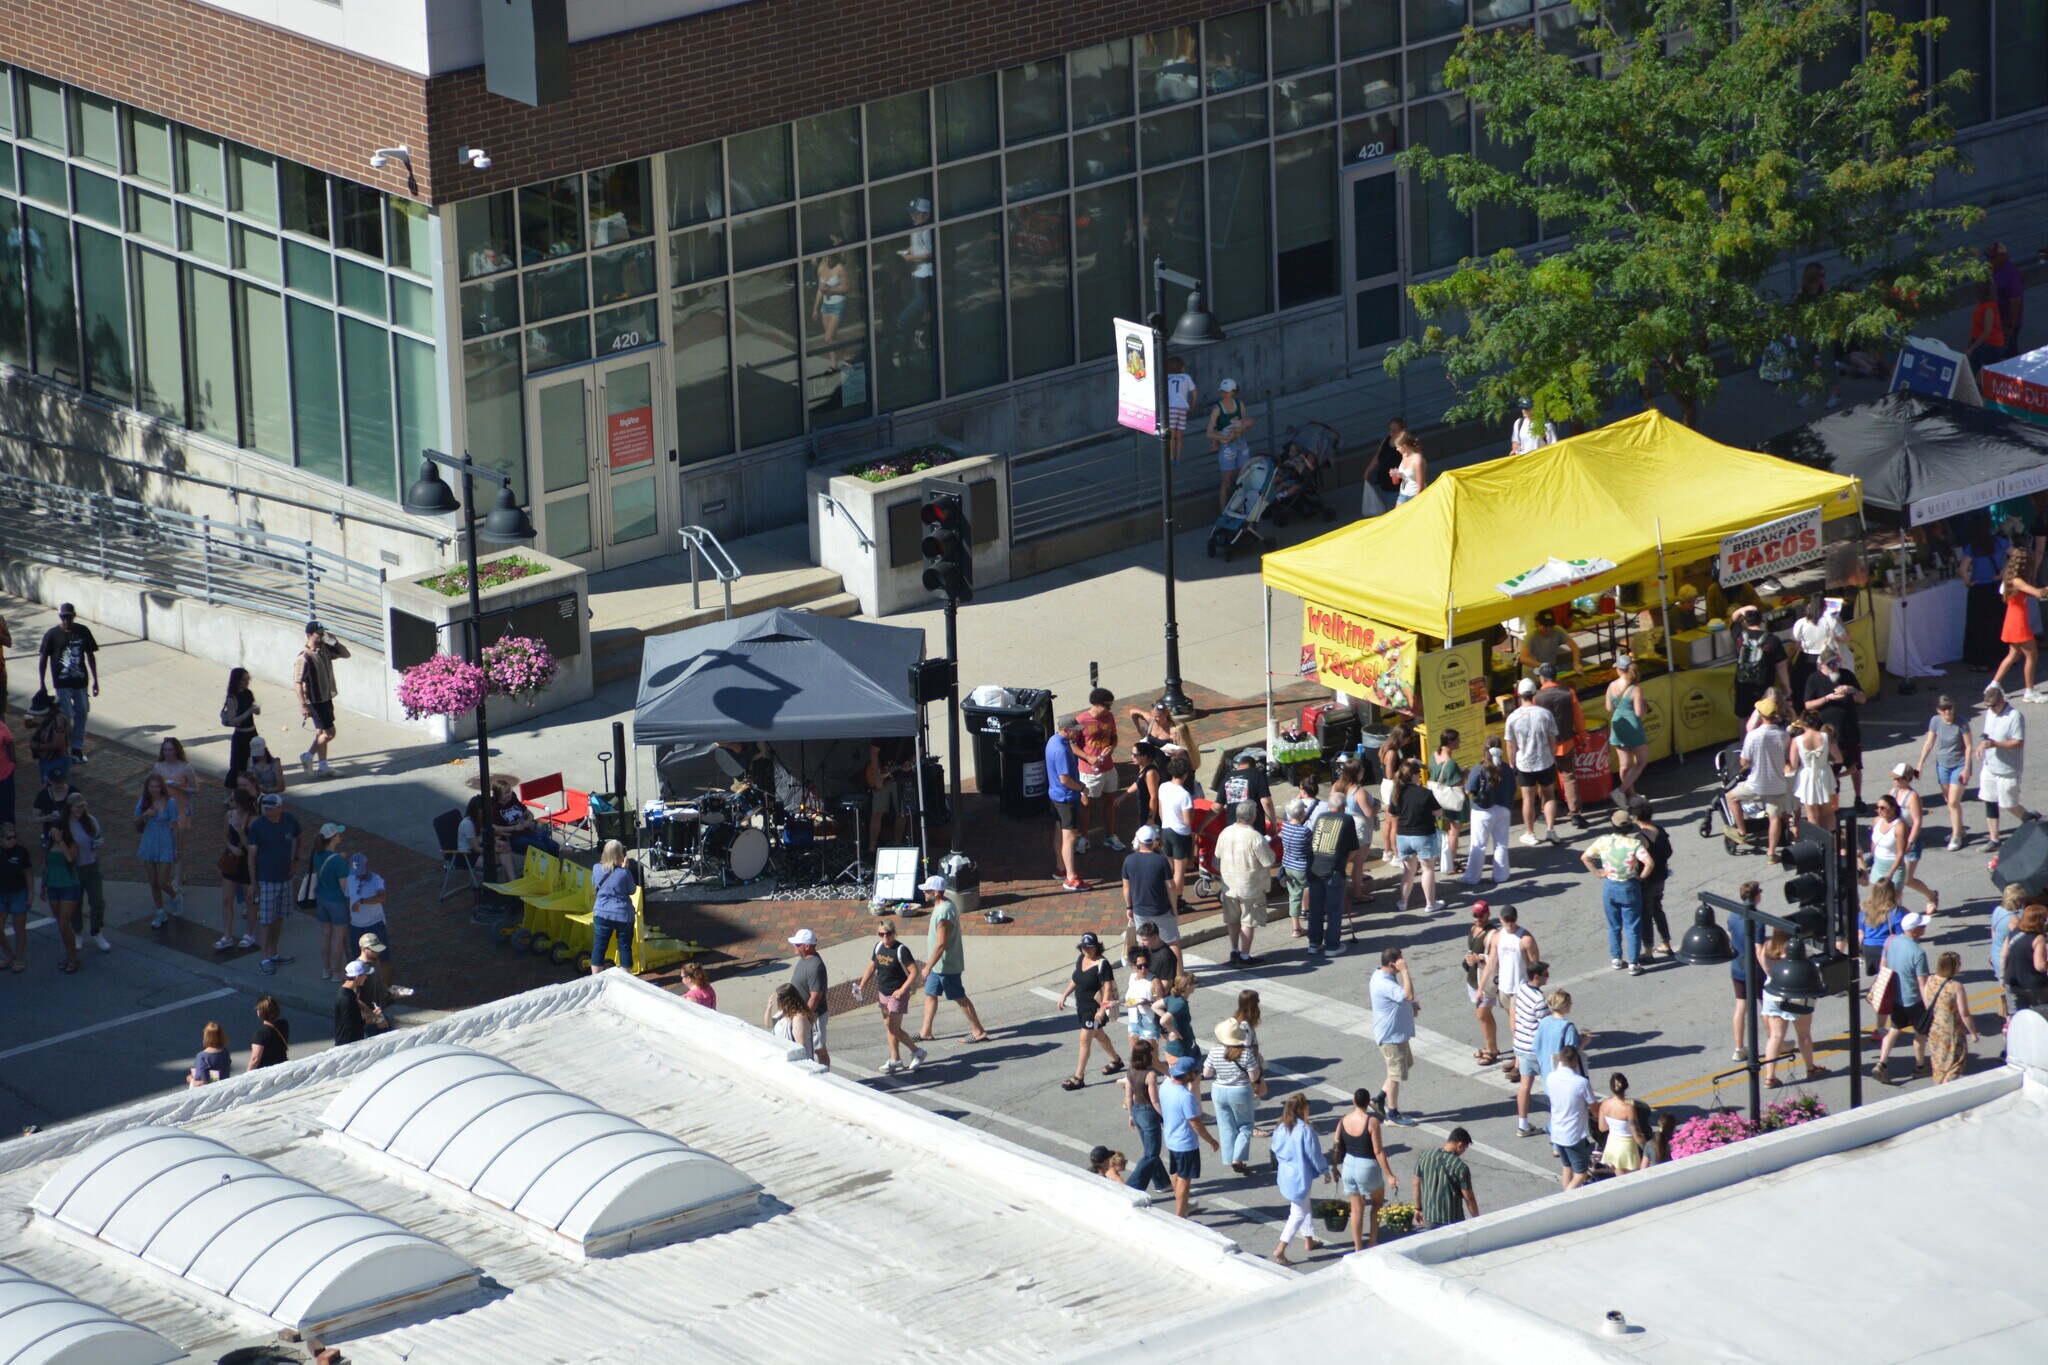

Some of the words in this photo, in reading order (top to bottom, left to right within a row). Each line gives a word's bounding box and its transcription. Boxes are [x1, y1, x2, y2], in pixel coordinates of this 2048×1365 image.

[1358, 141, 1384, 159] 420
[612, 331, 639, 350] 420
[1172, 379, 1180, 393] 7
[1992, 378, 2021, 400] MINI
[1733, 521, 1809, 553] BREAKFAST
[1727, 528, 1817, 574] TACOS
[1308, 606, 1375, 657] Walking
[1441, 669, 1465, 680] Roadside
[1441, 677, 1466, 690] Tacos
[1444, 699, 1466, 711] MENU
[1684, 710, 1710, 721] Tacos
